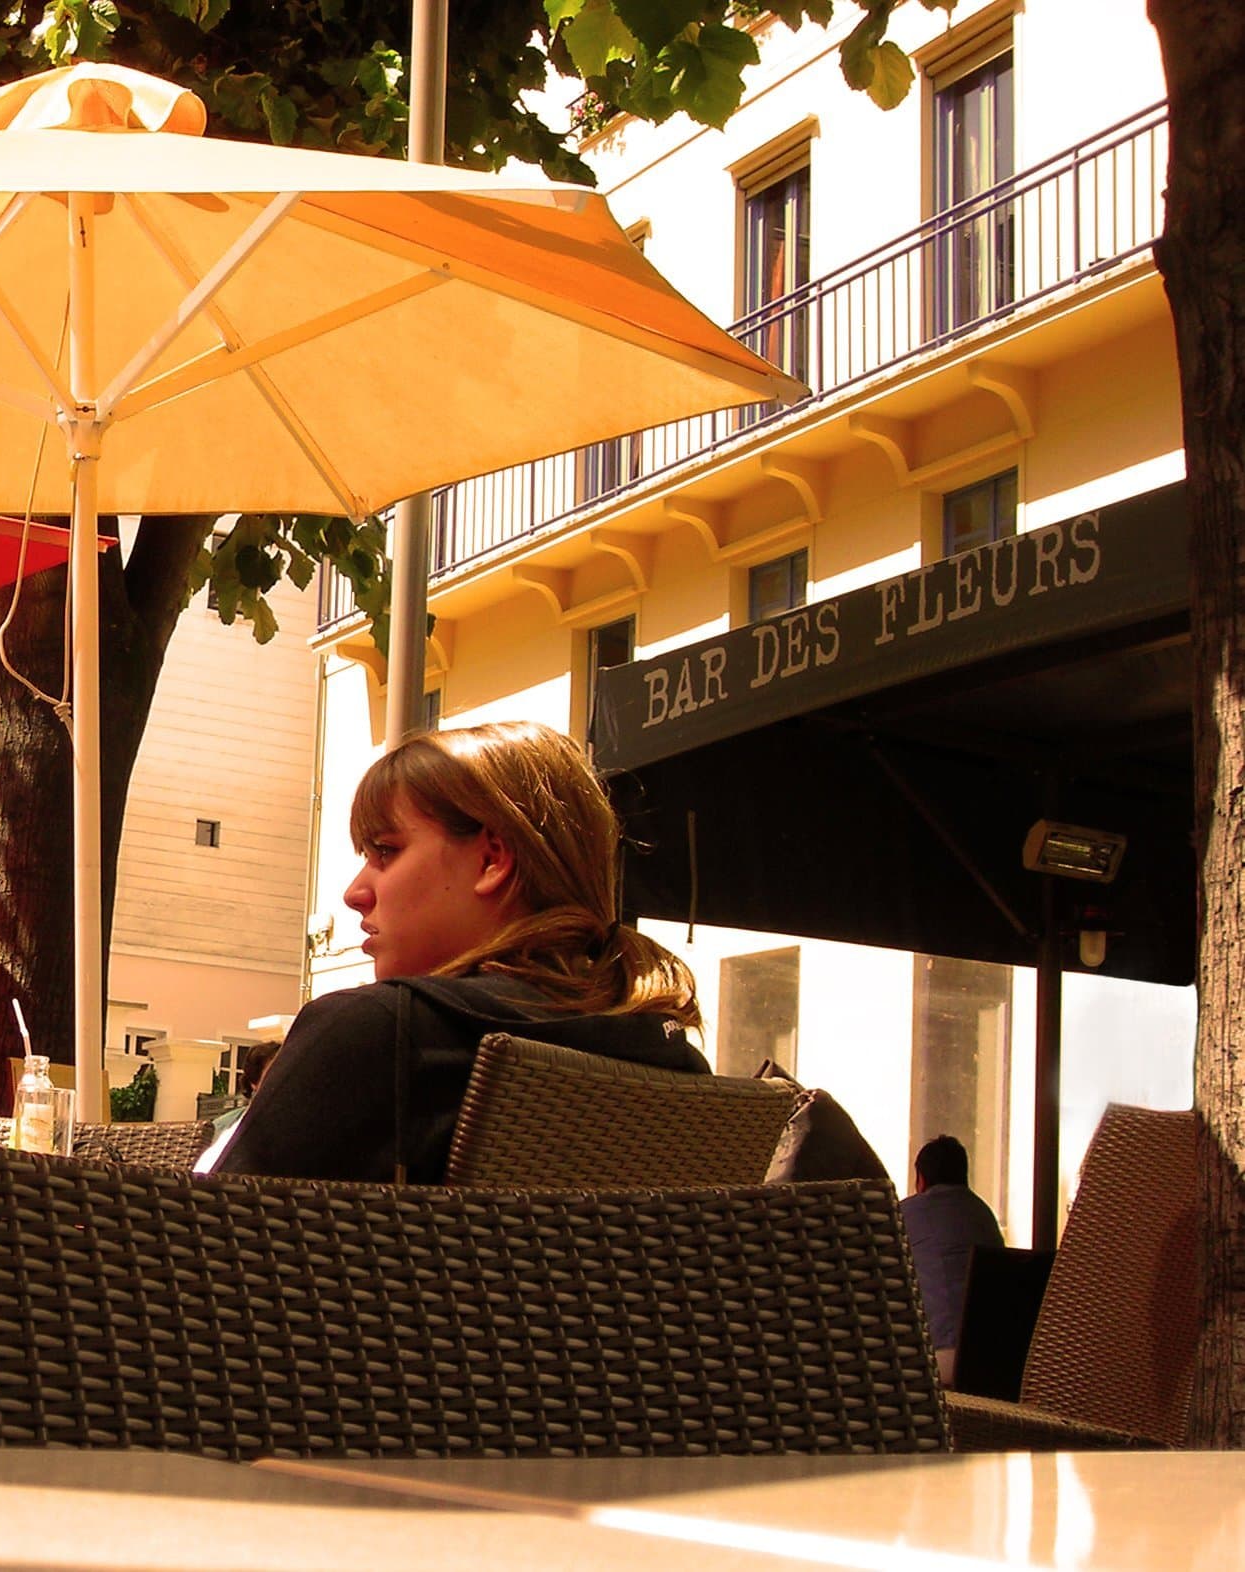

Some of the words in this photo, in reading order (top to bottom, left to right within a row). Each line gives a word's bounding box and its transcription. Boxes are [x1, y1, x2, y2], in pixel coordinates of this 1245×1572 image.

[642, 647, 729, 729] BAR
[751, 601, 840, 690] DES
[874, 512, 1102, 645] FLEURS
